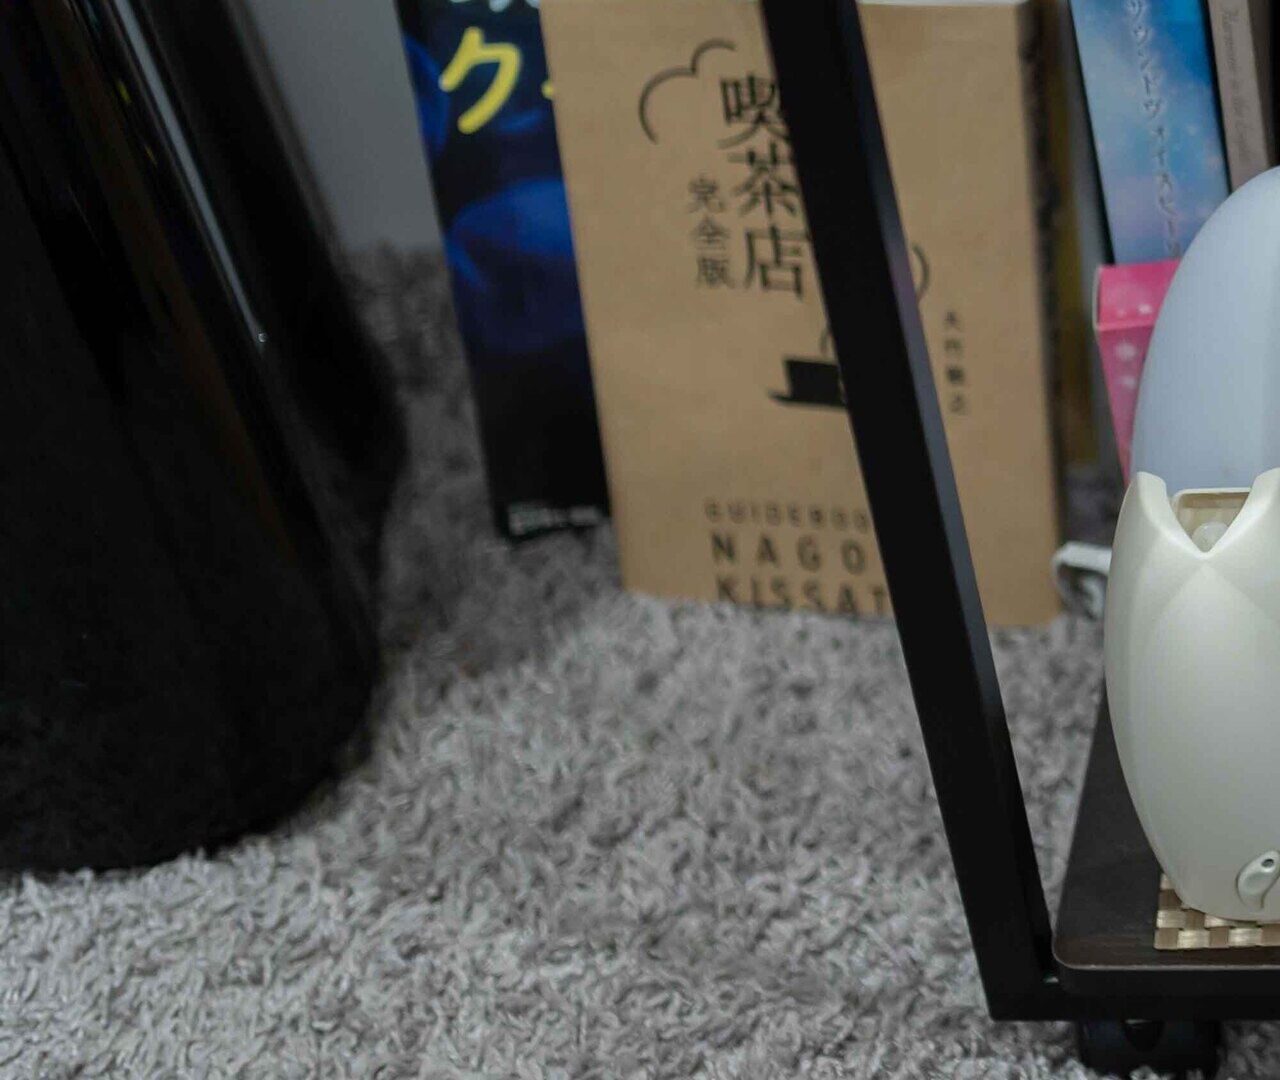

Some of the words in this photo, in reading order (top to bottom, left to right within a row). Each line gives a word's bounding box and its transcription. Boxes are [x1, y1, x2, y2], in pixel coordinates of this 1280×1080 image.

[438, 26, 556, 134] ク
[711, 532, 866, 576] NAGO
[717, 577, 886, 618] KISSAT
